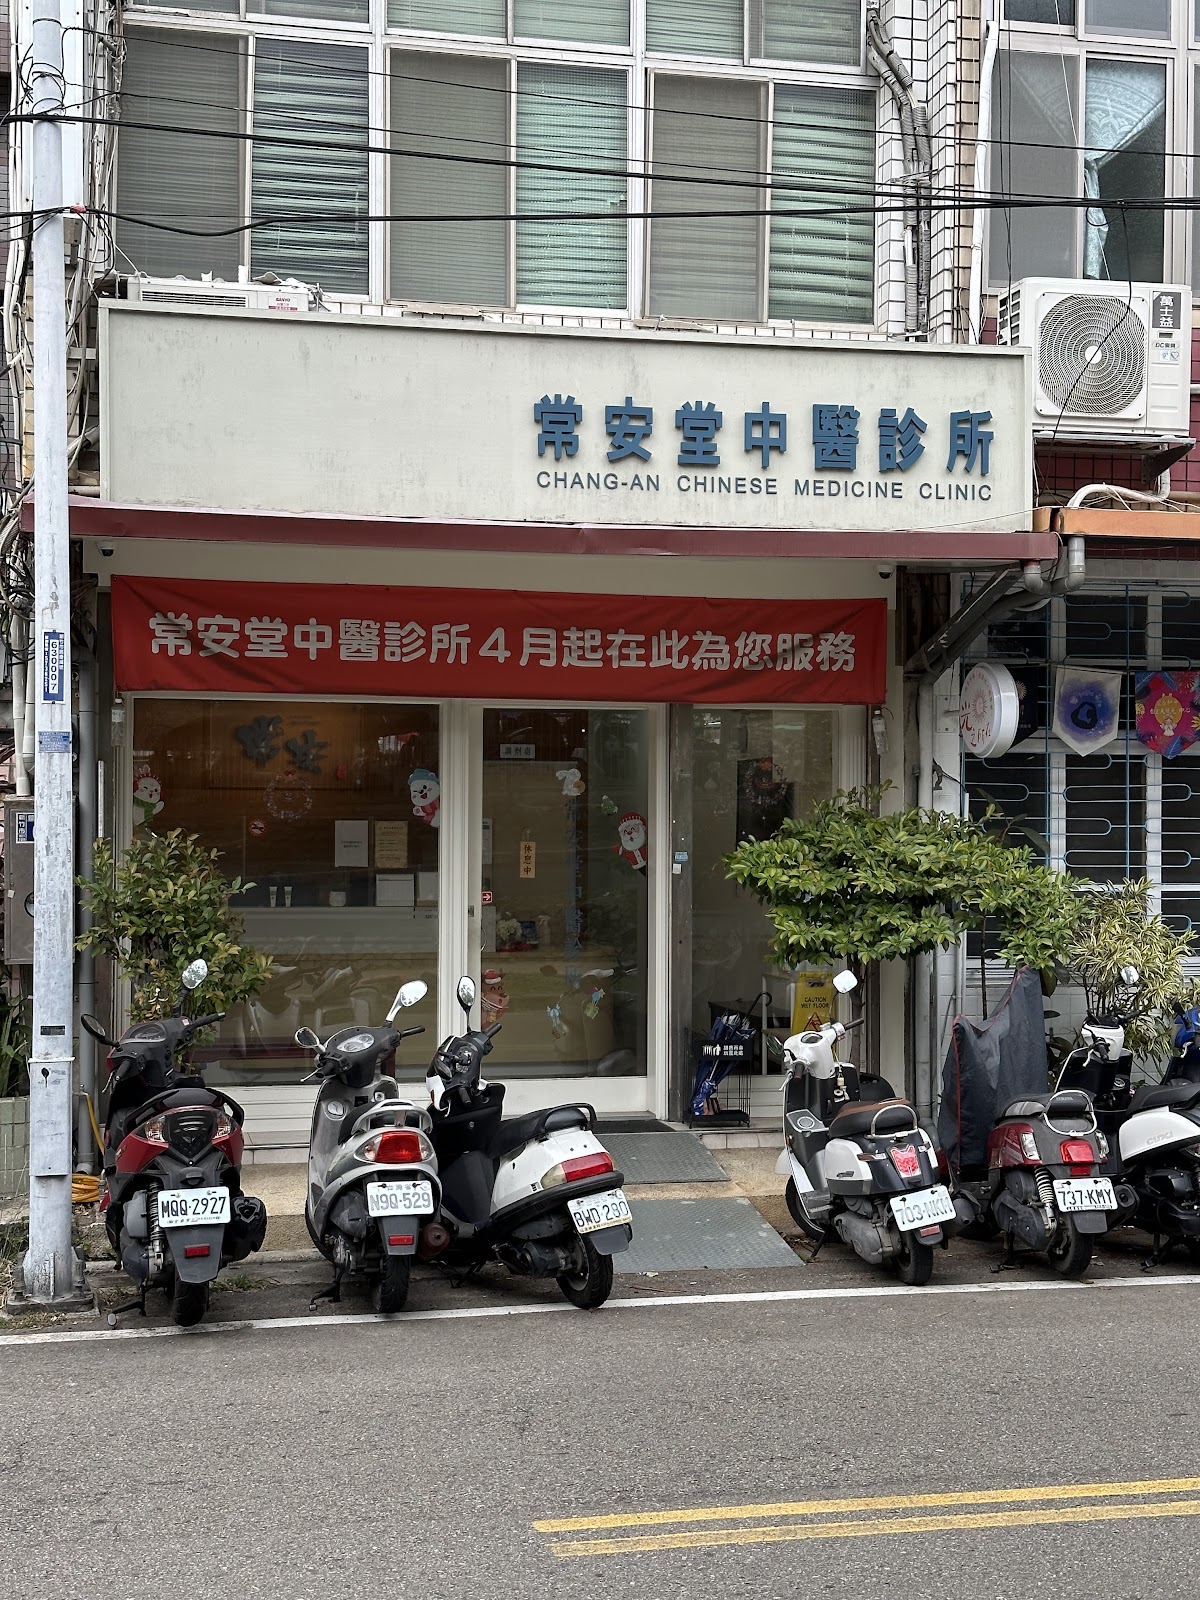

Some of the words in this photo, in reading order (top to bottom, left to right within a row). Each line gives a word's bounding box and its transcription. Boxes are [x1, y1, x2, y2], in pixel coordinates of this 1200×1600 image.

[534, 393, 995, 477] 常安堂中醫診所
[536, 470, 660, 491] CHANG-AN
[677, 474, 778, 495] CHINESE
[794, 478, 903, 499] MEDICINE
[919, 482, 992, 501] CLINIC
[50, 641, 58, 691] 630007
[149, 611, 856, 672] 常安堂中醫診所4月起在此為您服務
[522, 844, 533, 876] 休息中
